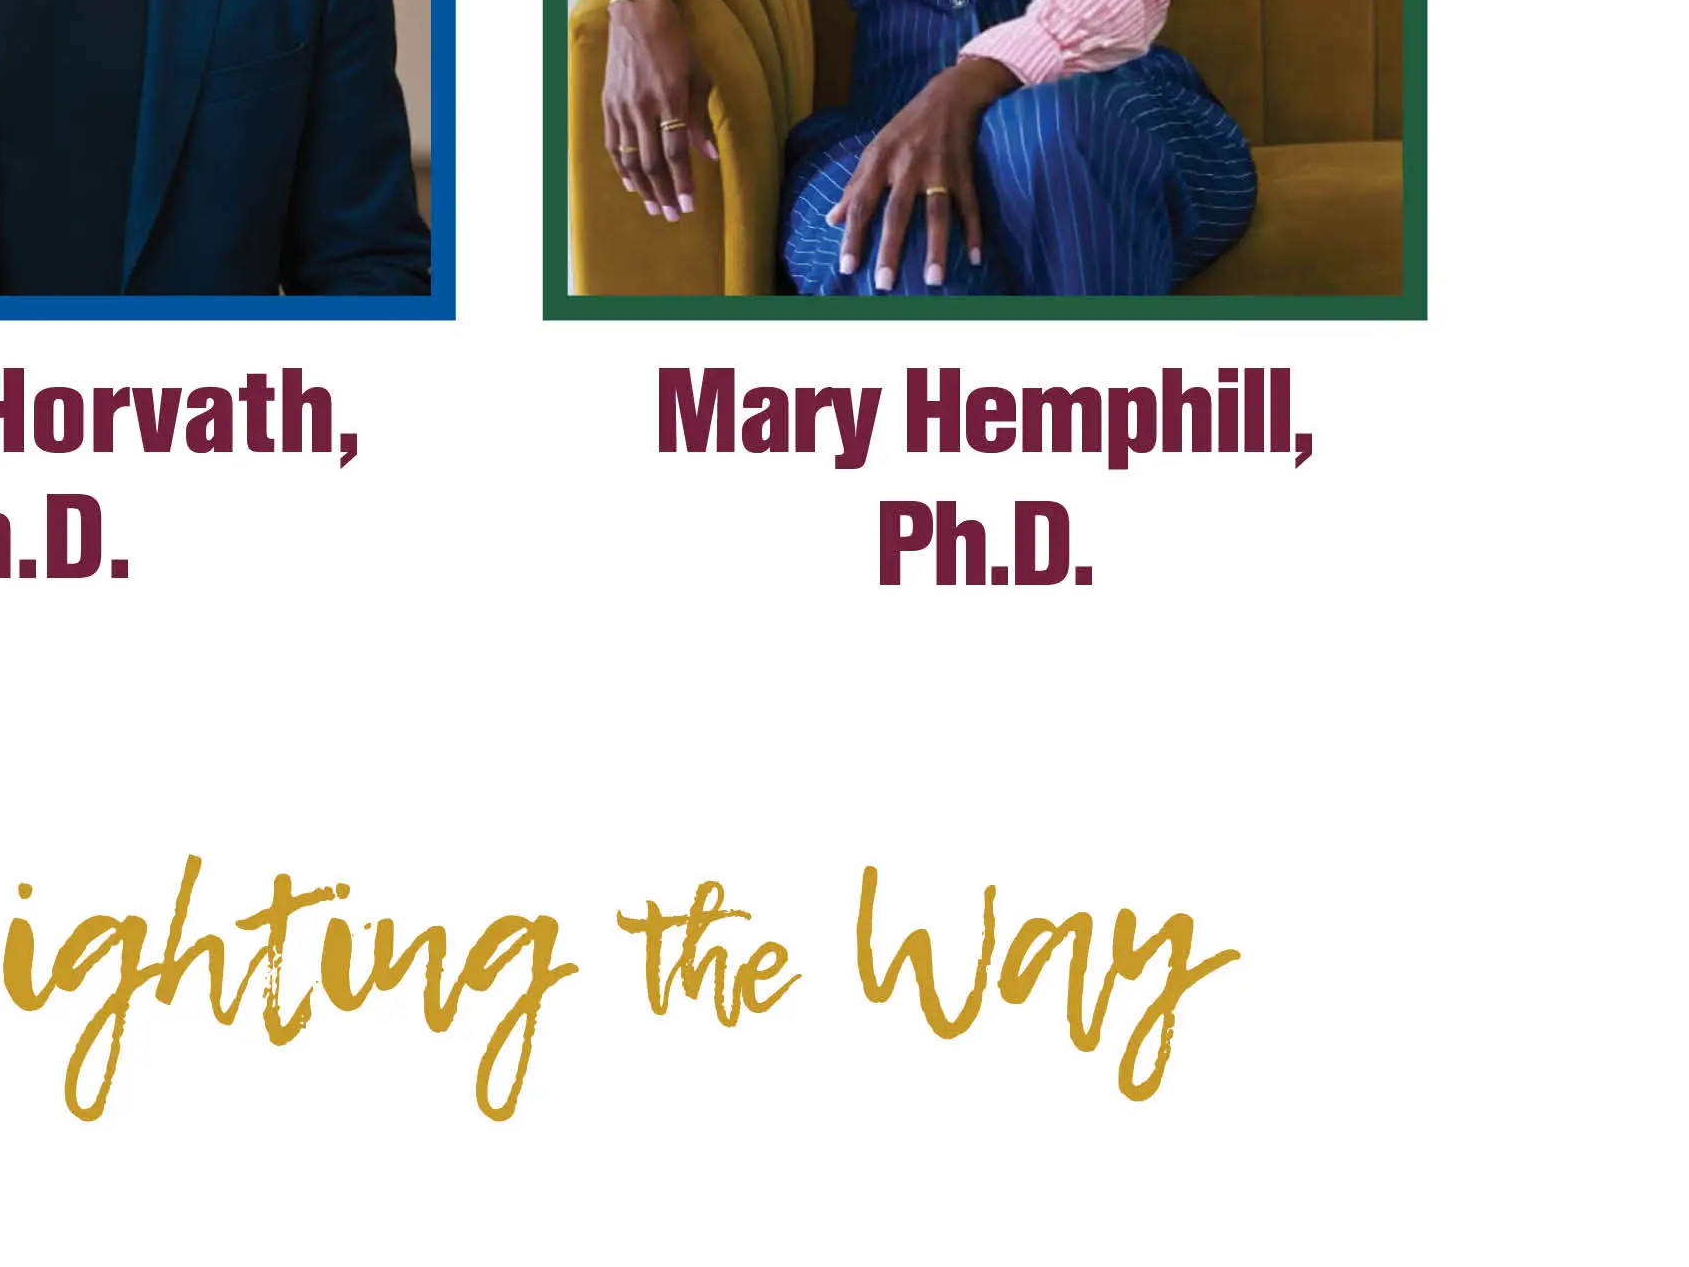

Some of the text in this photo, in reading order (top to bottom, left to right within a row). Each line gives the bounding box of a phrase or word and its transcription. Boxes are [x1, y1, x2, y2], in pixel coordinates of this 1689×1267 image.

[659, 368, 1312, 470] Mary Hemphill,
[880, 501, 1092, 585] Ph.D.
[617, 881, 802, 1027] the
[857, 866, 1241, 1101] Way
